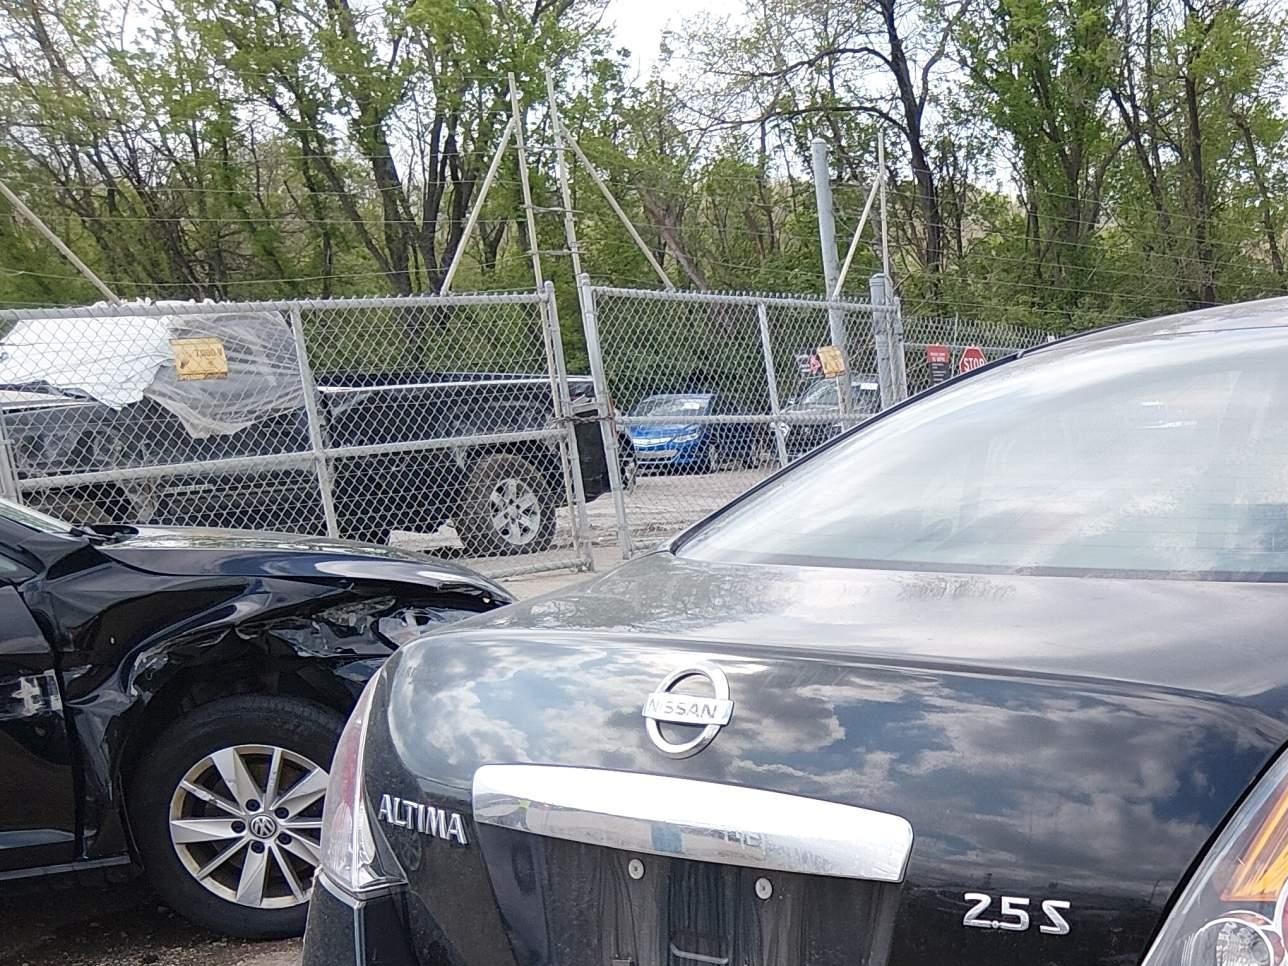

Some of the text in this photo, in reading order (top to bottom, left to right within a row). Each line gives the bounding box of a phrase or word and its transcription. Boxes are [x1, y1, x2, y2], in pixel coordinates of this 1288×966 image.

[646, 697, 718, 719] NSSAN
[378, 793, 468, 845] ALTIMA
[963, 892, 1071, 935] 2.5 S
